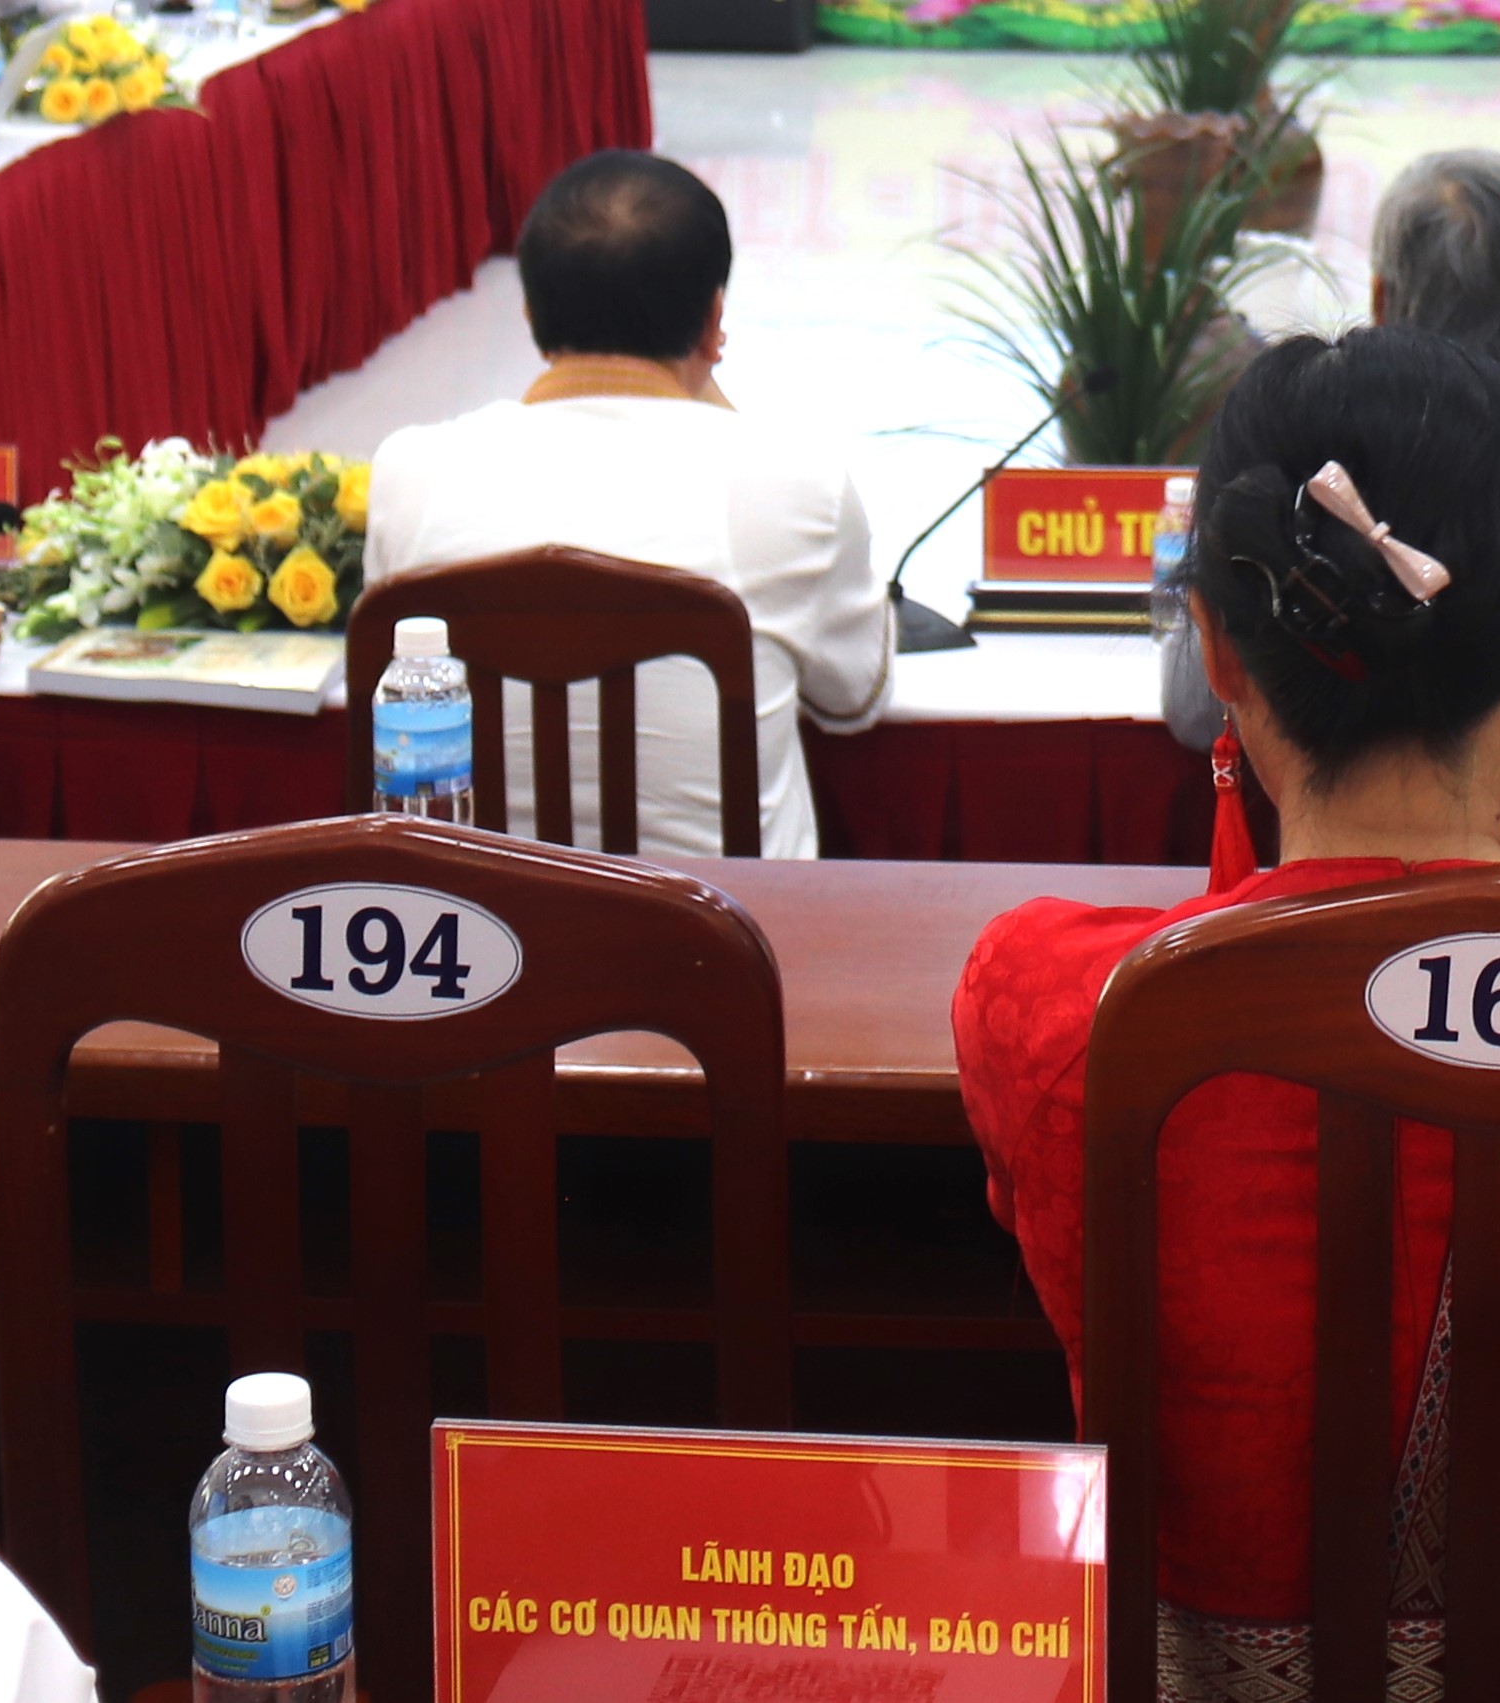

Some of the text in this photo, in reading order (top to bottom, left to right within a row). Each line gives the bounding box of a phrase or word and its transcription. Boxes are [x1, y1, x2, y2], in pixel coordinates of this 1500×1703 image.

[1017, 496, 1104, 557] CHỦ
[290, 905, 471, 1000] 194
[680, 1541, 855, 1596] LÃNH ĐẠO
[468, 1592, 1071, 1659] CÁC CƠ QUAN THÔNG TẤN, BÁO CHÍ
